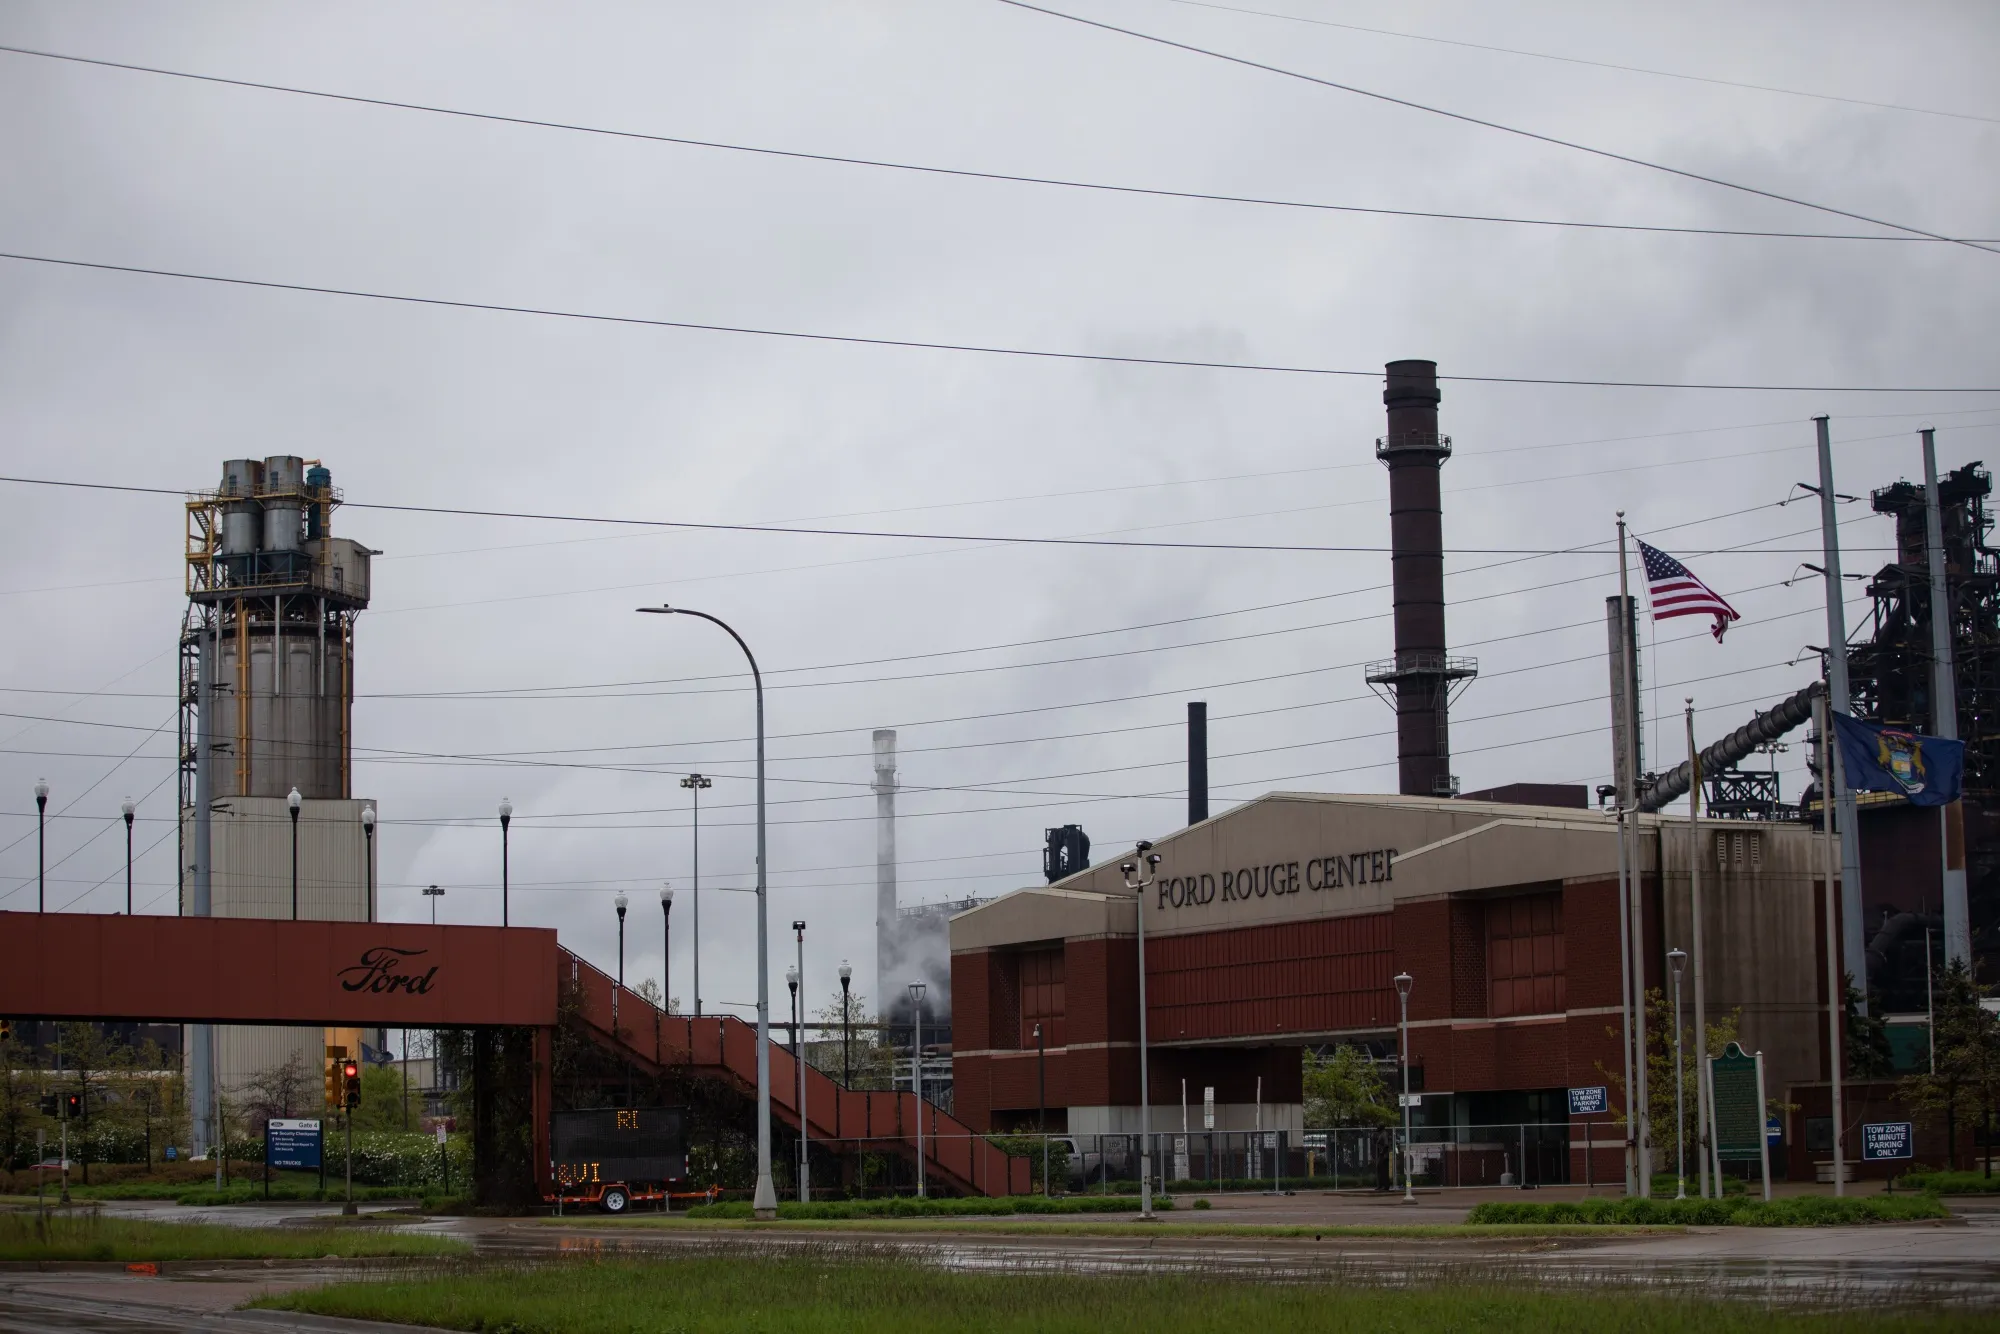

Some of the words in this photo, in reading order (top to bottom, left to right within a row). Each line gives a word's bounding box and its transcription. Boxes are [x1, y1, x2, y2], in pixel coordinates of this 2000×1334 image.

[1157, 873, 1216, 910] FORD
[1221, 861, 1300, 902] ROUGE
[337, 947, 439, 995] Ford
[1866, 1126, 1884, 1134] TOW
[1885, 1125, 1907, 1133] ZONE
[1877, 1133, 1906, 1141] MINUTE
[1868, 1141, 1903, 1149] PARKING
